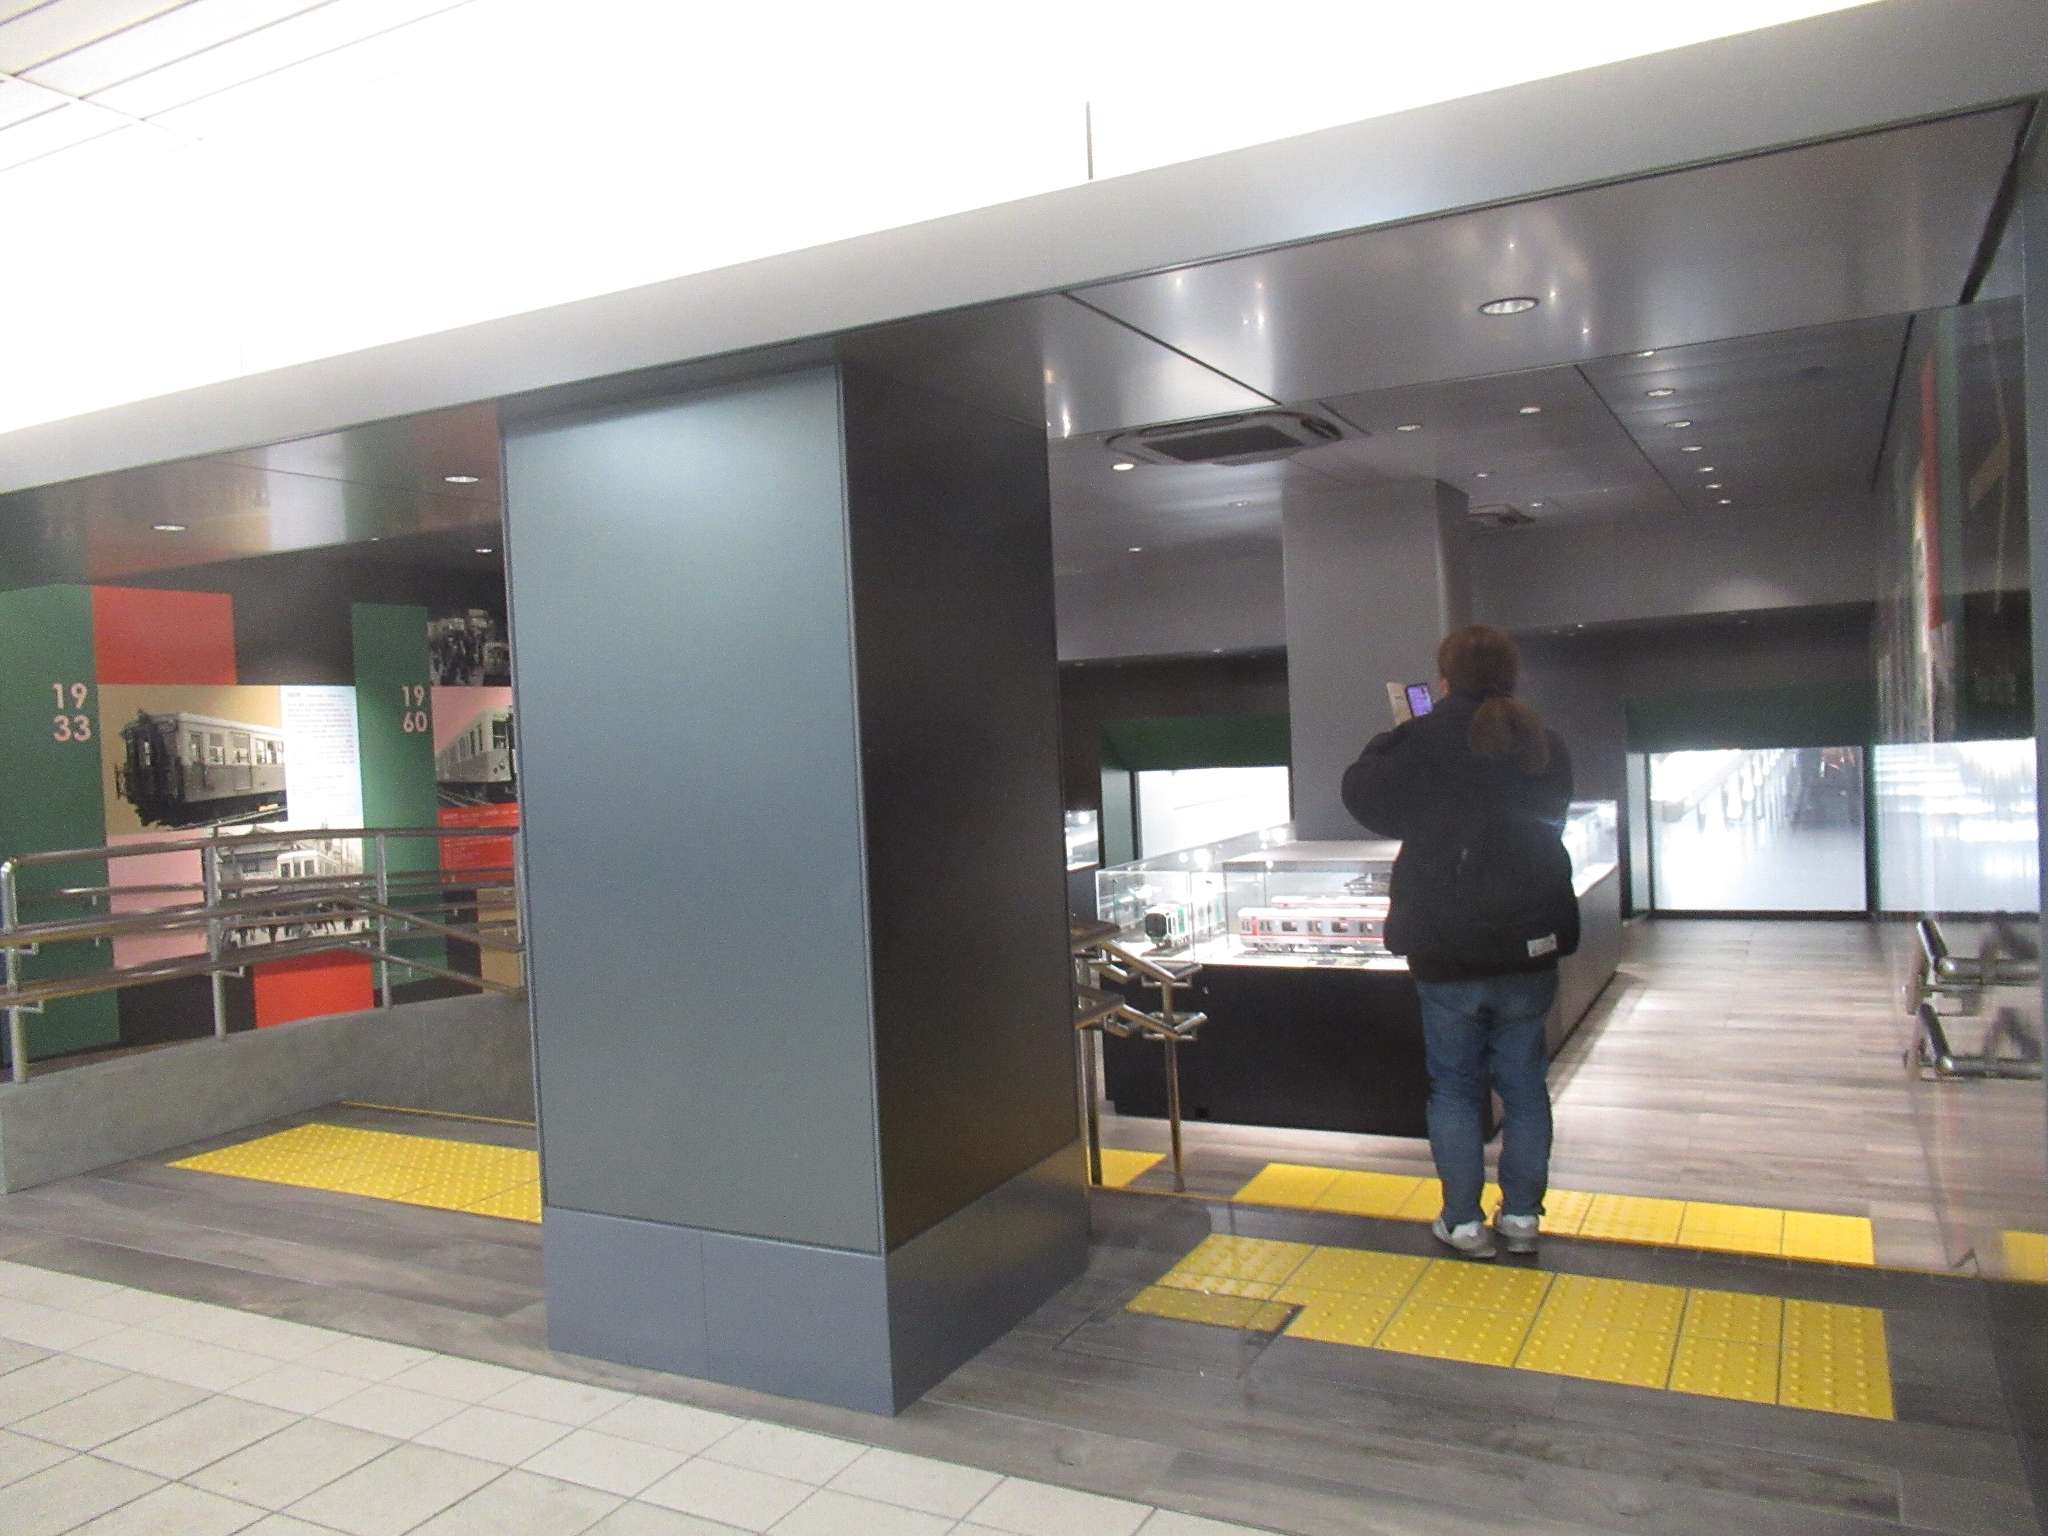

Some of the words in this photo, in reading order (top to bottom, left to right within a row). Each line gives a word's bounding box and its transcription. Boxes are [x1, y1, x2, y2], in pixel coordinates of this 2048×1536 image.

[53, 684, 87, 709] 19
[402, 685, 425, 706] 19
[54, 715, 91, 741] 33
[404, 711, 427, 732] 60
